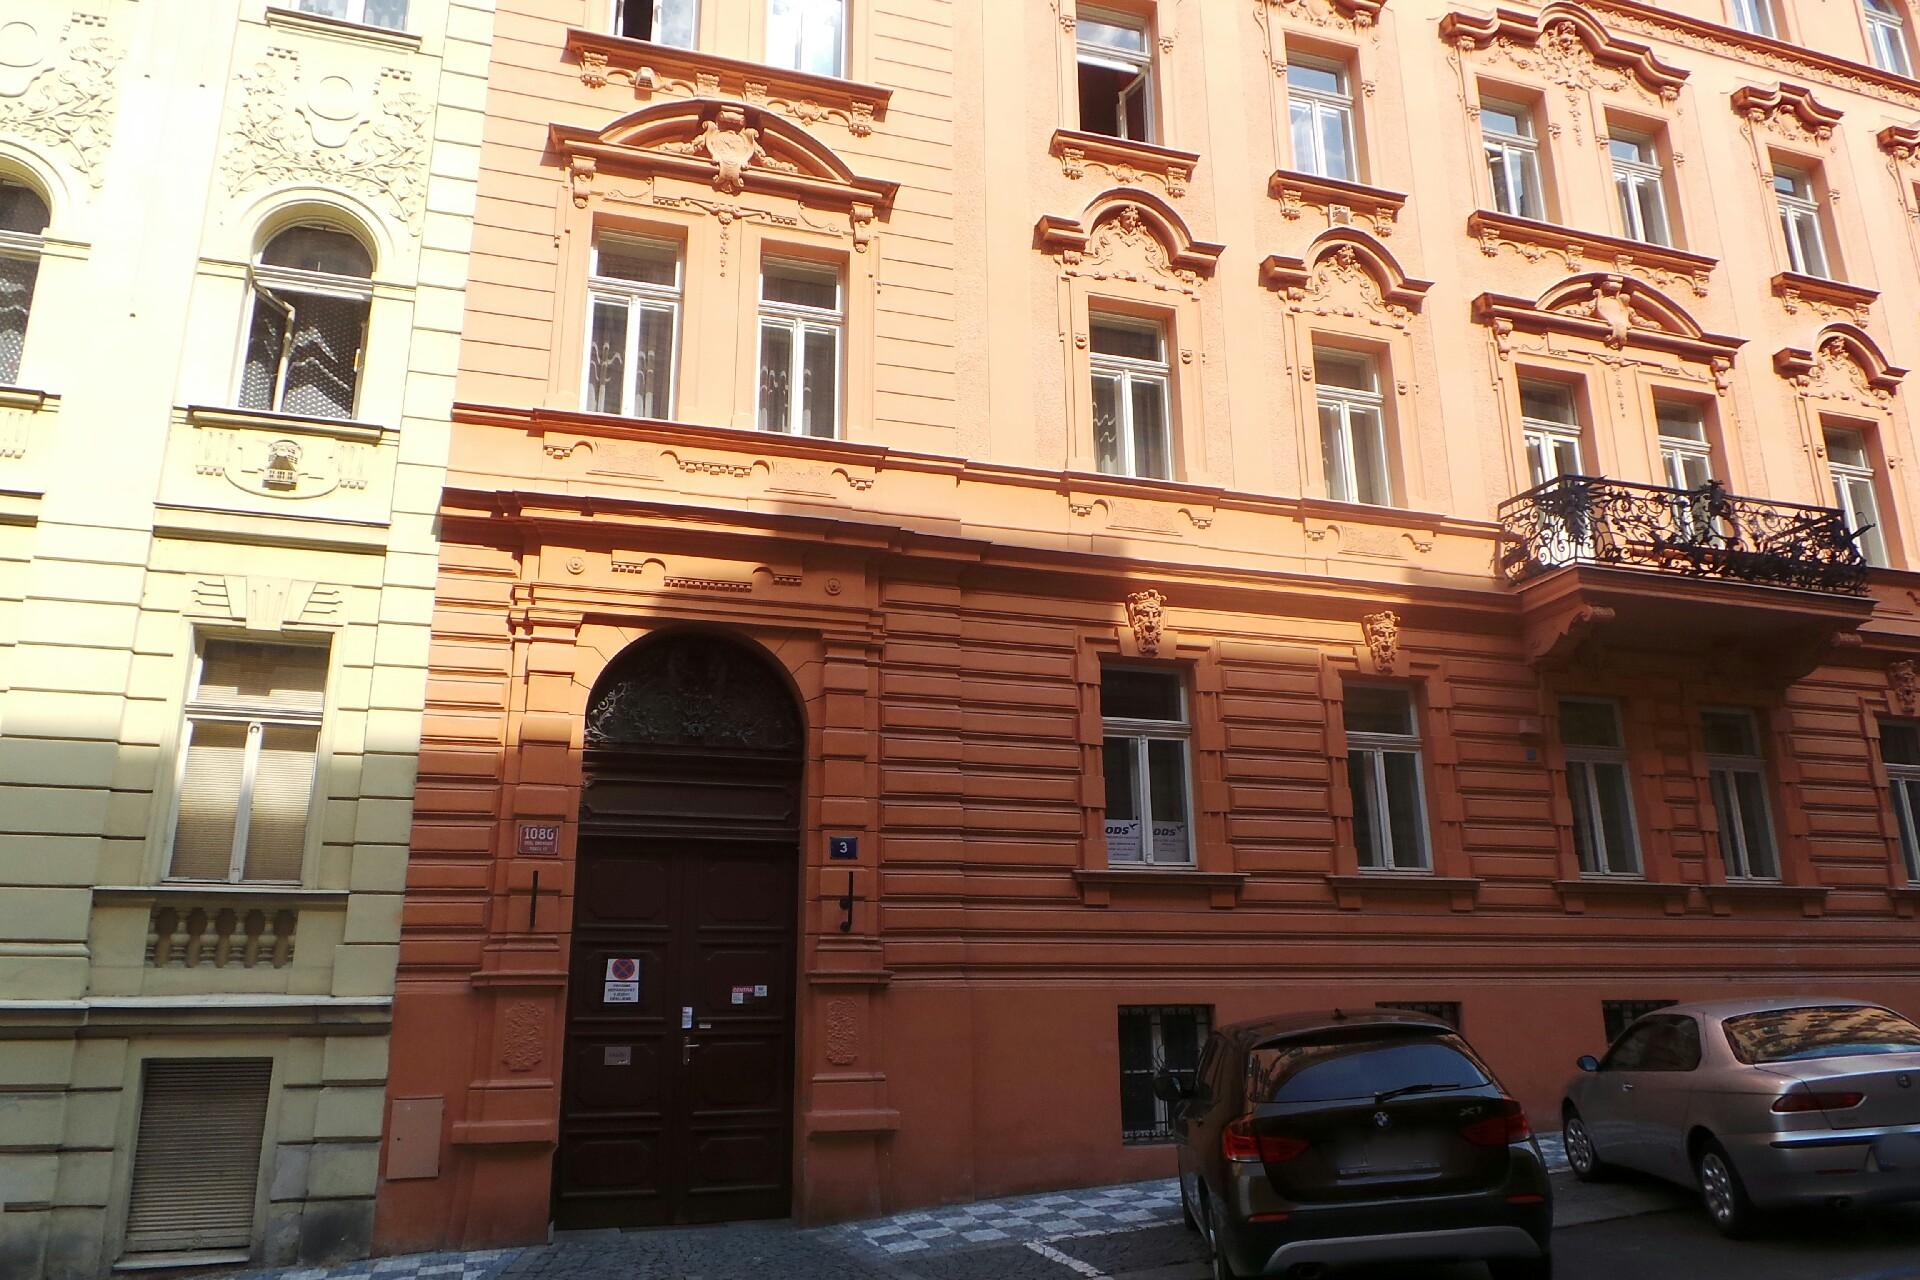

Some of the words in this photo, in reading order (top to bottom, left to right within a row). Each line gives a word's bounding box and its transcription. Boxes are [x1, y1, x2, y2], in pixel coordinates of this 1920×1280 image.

[1105, 826, 1129, 835] ODS
[839, 841, 848, 853] 3
[1459, 1105, 1482, 1116] X1
